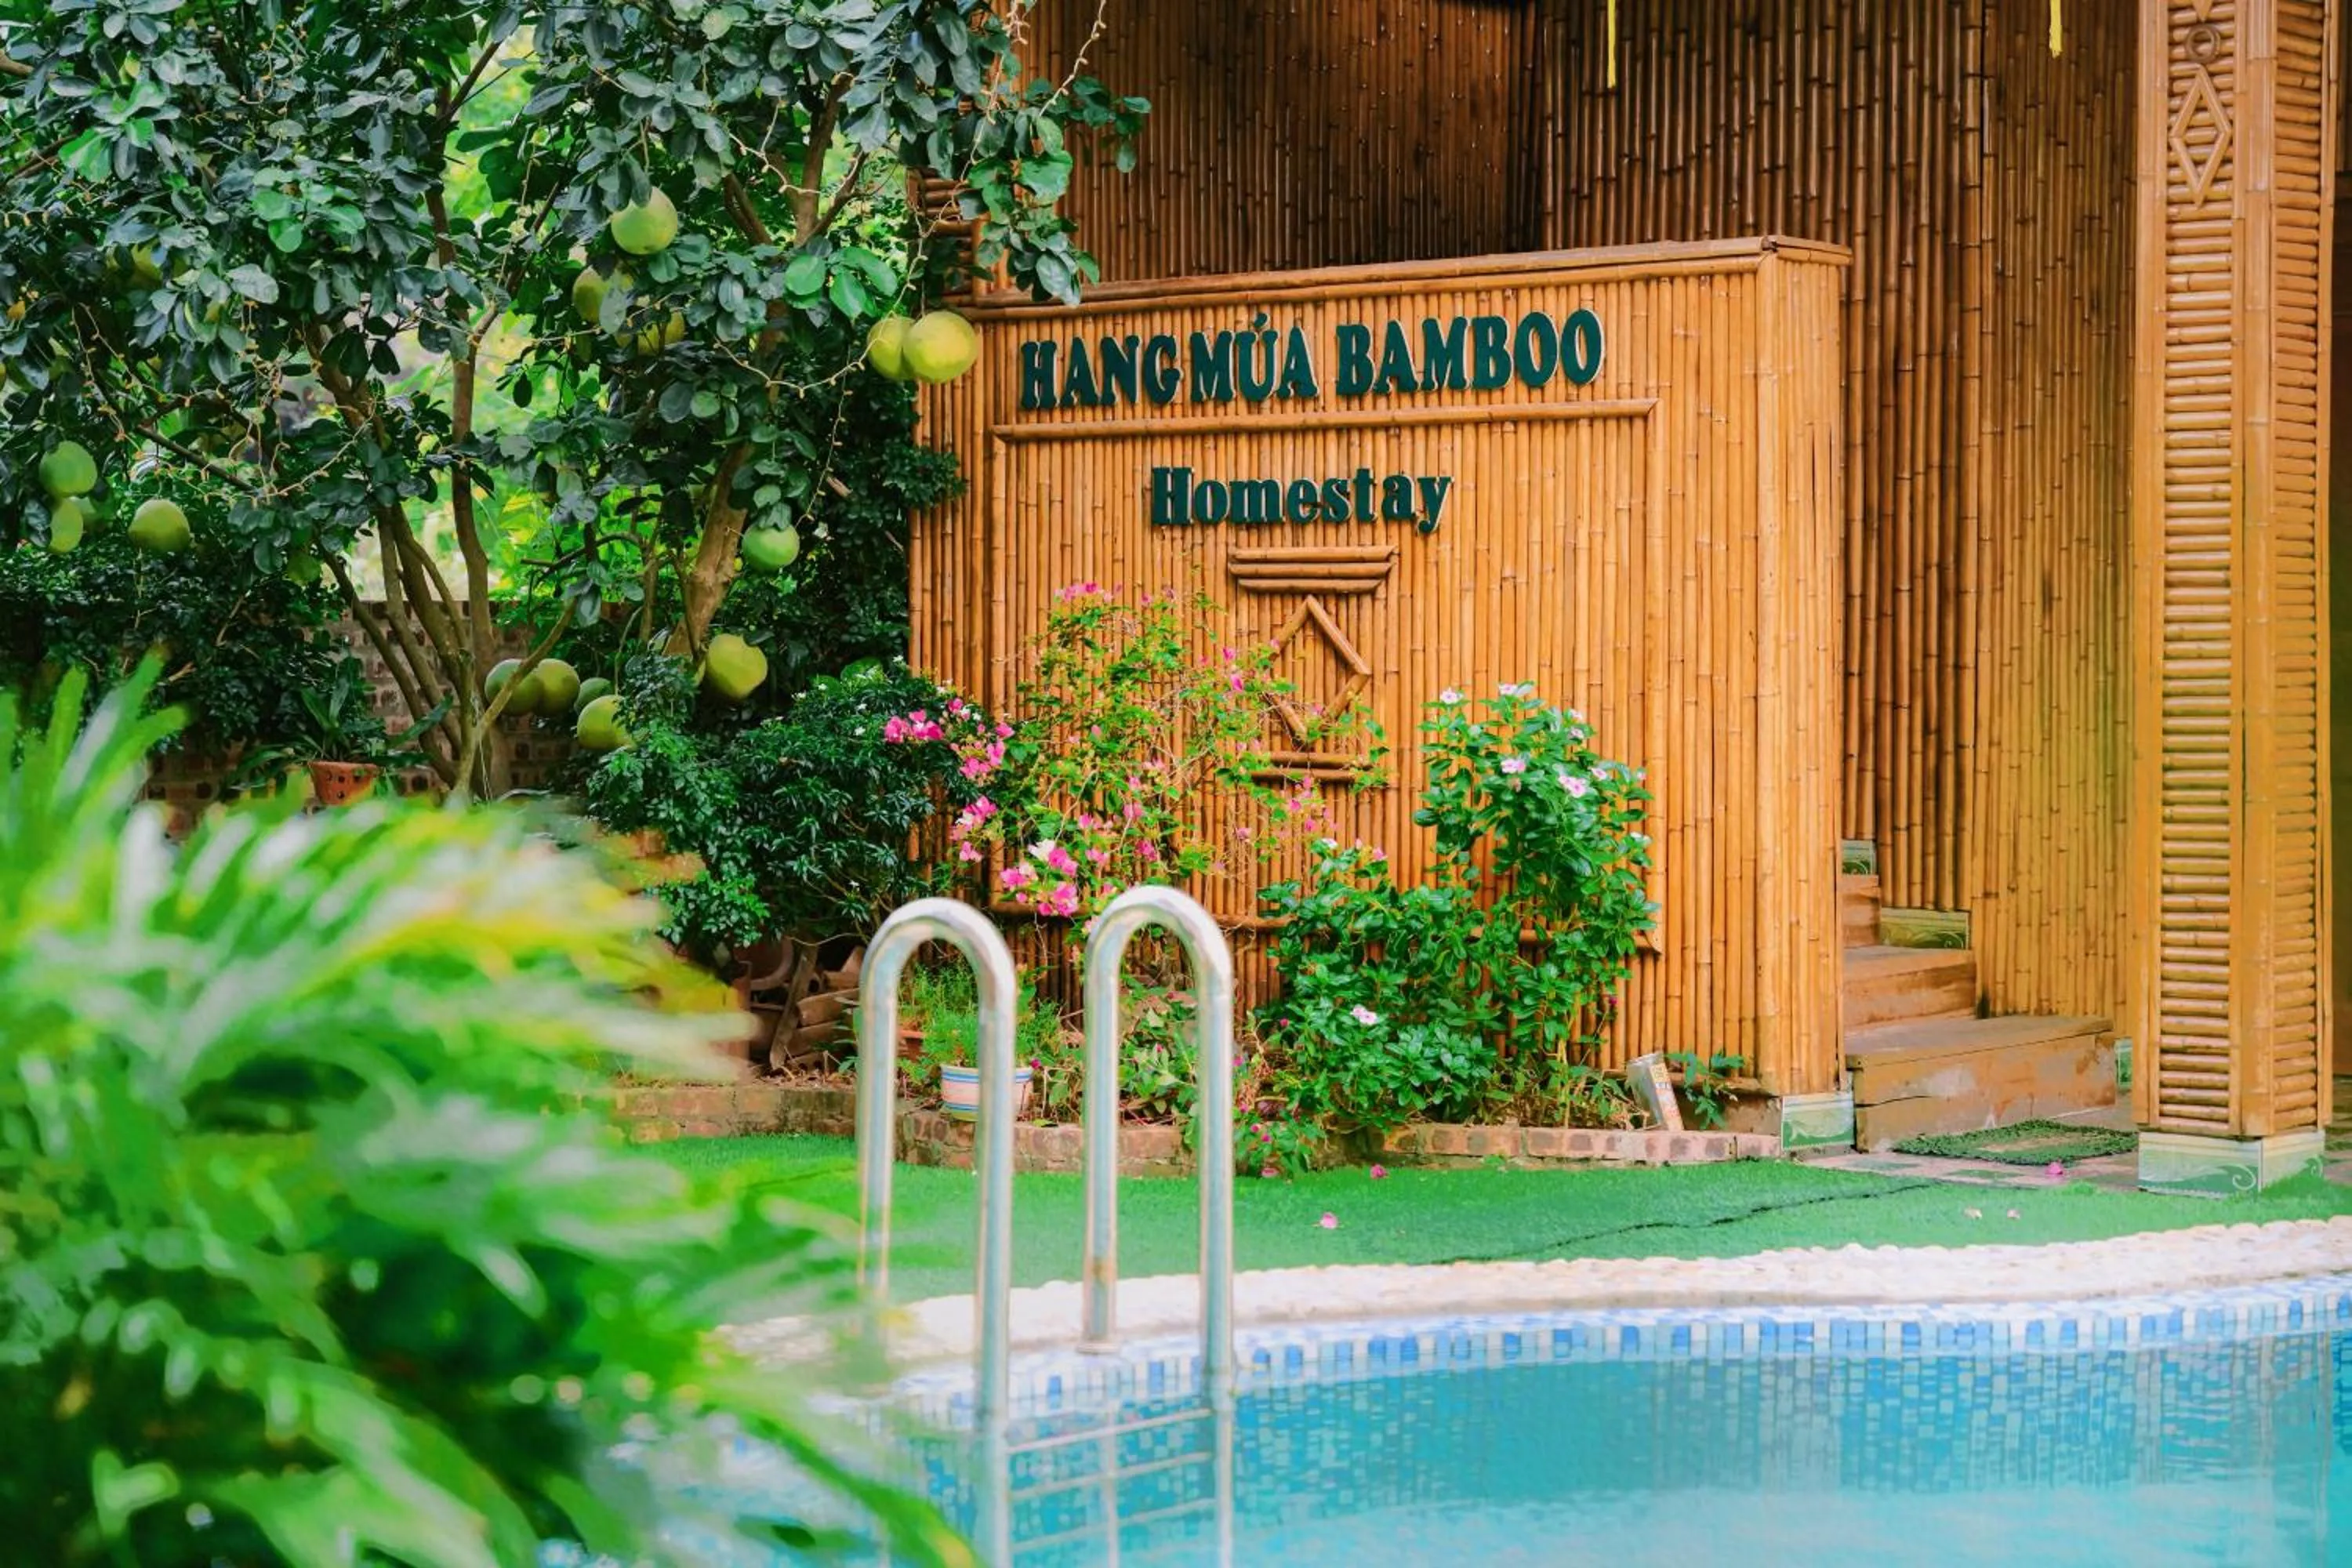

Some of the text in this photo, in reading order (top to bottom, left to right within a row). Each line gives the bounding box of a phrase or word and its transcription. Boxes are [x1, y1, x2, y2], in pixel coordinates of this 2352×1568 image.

[1020, 308, 1604, 409] HANG MÚA BAMBOO
[1152, 466, 1454, 533] Homestay
